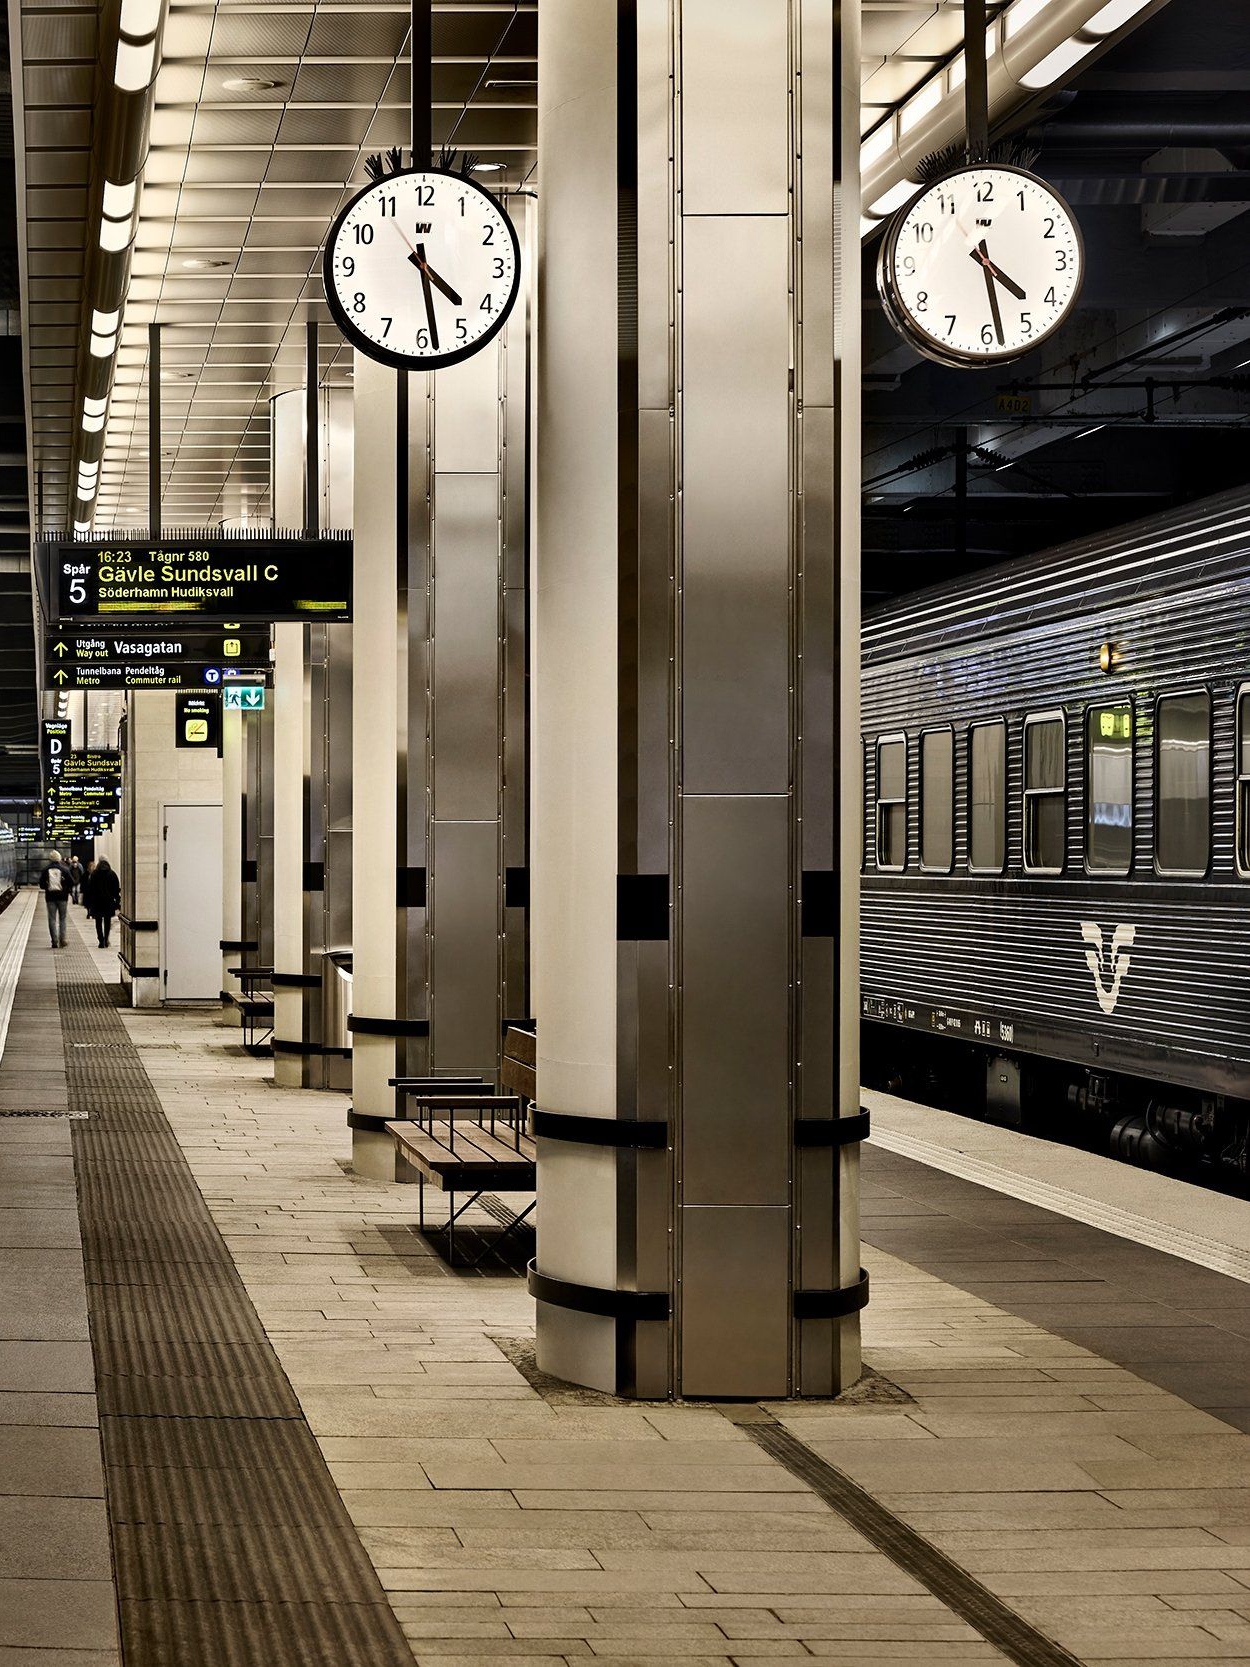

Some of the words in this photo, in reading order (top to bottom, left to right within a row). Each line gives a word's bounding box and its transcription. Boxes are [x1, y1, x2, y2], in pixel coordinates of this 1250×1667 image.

[414, 185, 435, 206] 12
[973, 181, 994, 202] 12
[1016, 190, 1025, 211] 1
[378, 196, 396, 217] 11
[458, 197, 465, 217] 1
[937, 193, 955, 214] 11
[352, 223, 374, 245] 10
[482, 225, 494, 246] 2
[912, 222, 933, 243] 10
[1043, 217, 1055, 239] 2
[342, 256, 355, 277] 9
[492, 257, 504, 279] 3
[903, 256, 915, 277] 9
[1055, 250, 1067, 271] 3
[353, 292, 366, 313] 8
[479, 293, 493, 314] 4
[916, 291, 928, 312] 8
[1043, 286, 1056, 307] 4
[380, 317, 393, 338] 7
[455, 318, 467, 339] 5
[944, 315, 956, 335] 7
[1020, 312, 1032, 333] 5
[416, 328, 428, 348] 6
[980, 324, 993, 344] 6
[97, 550, 132, 563] 16:23
[148, 550, 185, 564] Tågnr
[188, 551, 210, 562] 580
[63, 563, 91, 576] Spår
[98, 565, 155, 582] Gävle
[161, 565, 258, 582] Sundsvall
[264, 565, 279, 581] C
[69, 578, 86, 604] 5
[98, 587, 168, 598] Söderhamn
[171, 586, 234, 597] Hudiksvall
[76, 639, 106, 650] Utgång
[76, 649, 93, 659] Way
[113, 641, 182, 656] Vasagatan
[76, 667, 122, 675] Tunnelbana
[76, 677, 100, 685] Metro
[125, 666, 165, 676] Pendeltåg
[125, 676, 167, 684] Commuter
[168, 675, 181, 684] rail
[50, 738, 62, 754] D
[52, 764, 61, 775] 5
[86, 759, 122, 767] Sundsval
